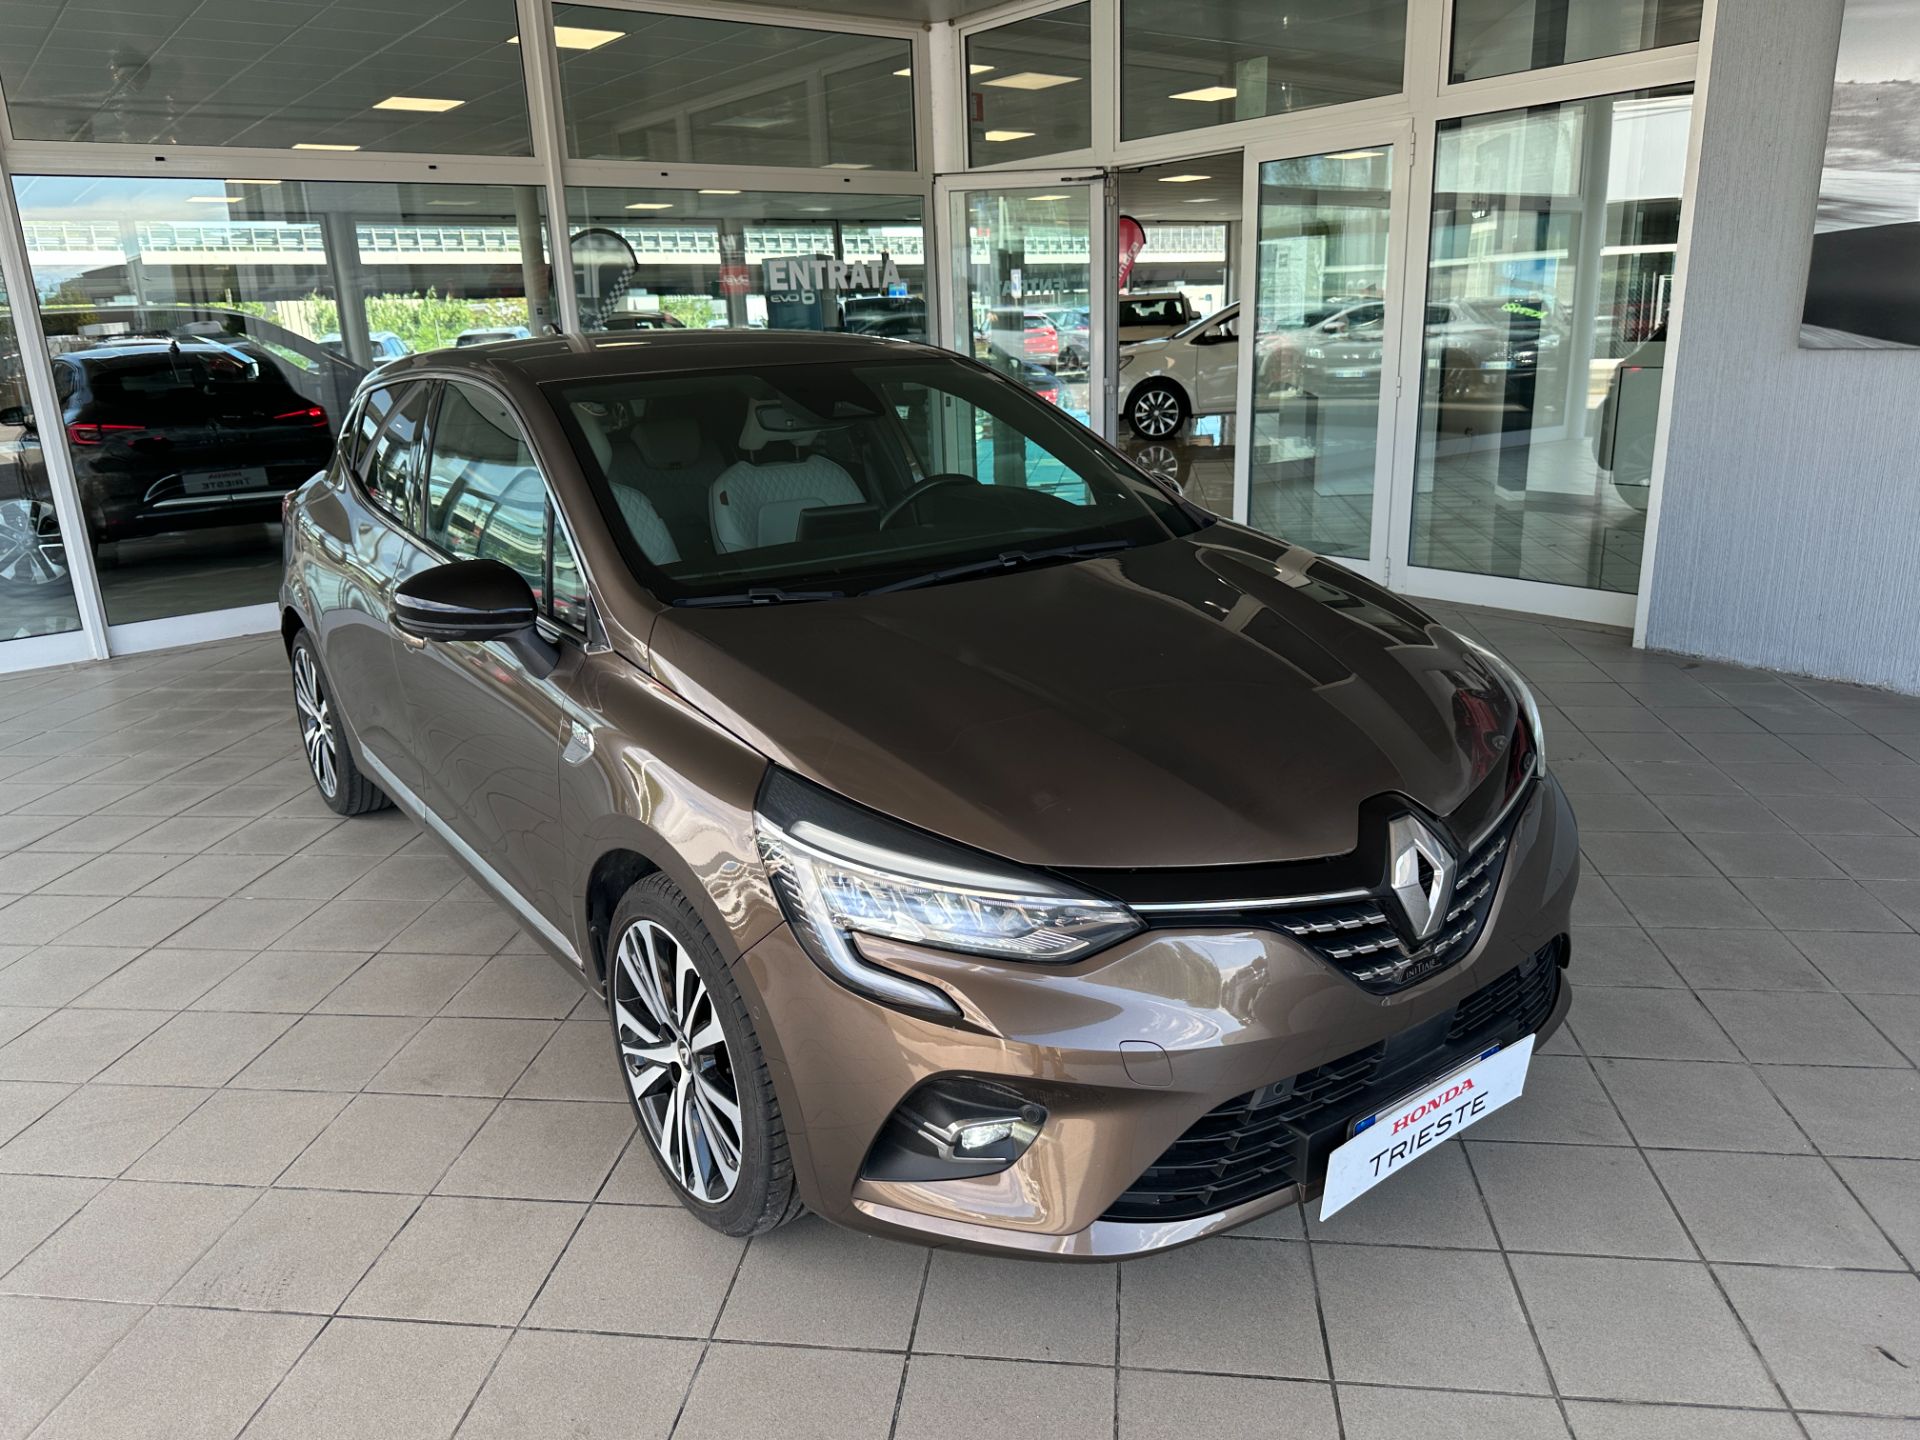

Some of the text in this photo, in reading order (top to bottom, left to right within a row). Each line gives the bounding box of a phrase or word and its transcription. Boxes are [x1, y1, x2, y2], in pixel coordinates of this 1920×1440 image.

[769, 260, 900, 290] ENTRATA
[1370, 1091, 1488, 1177] TRIESTE
[1391, 1078, 1475, 1135] HONDA
